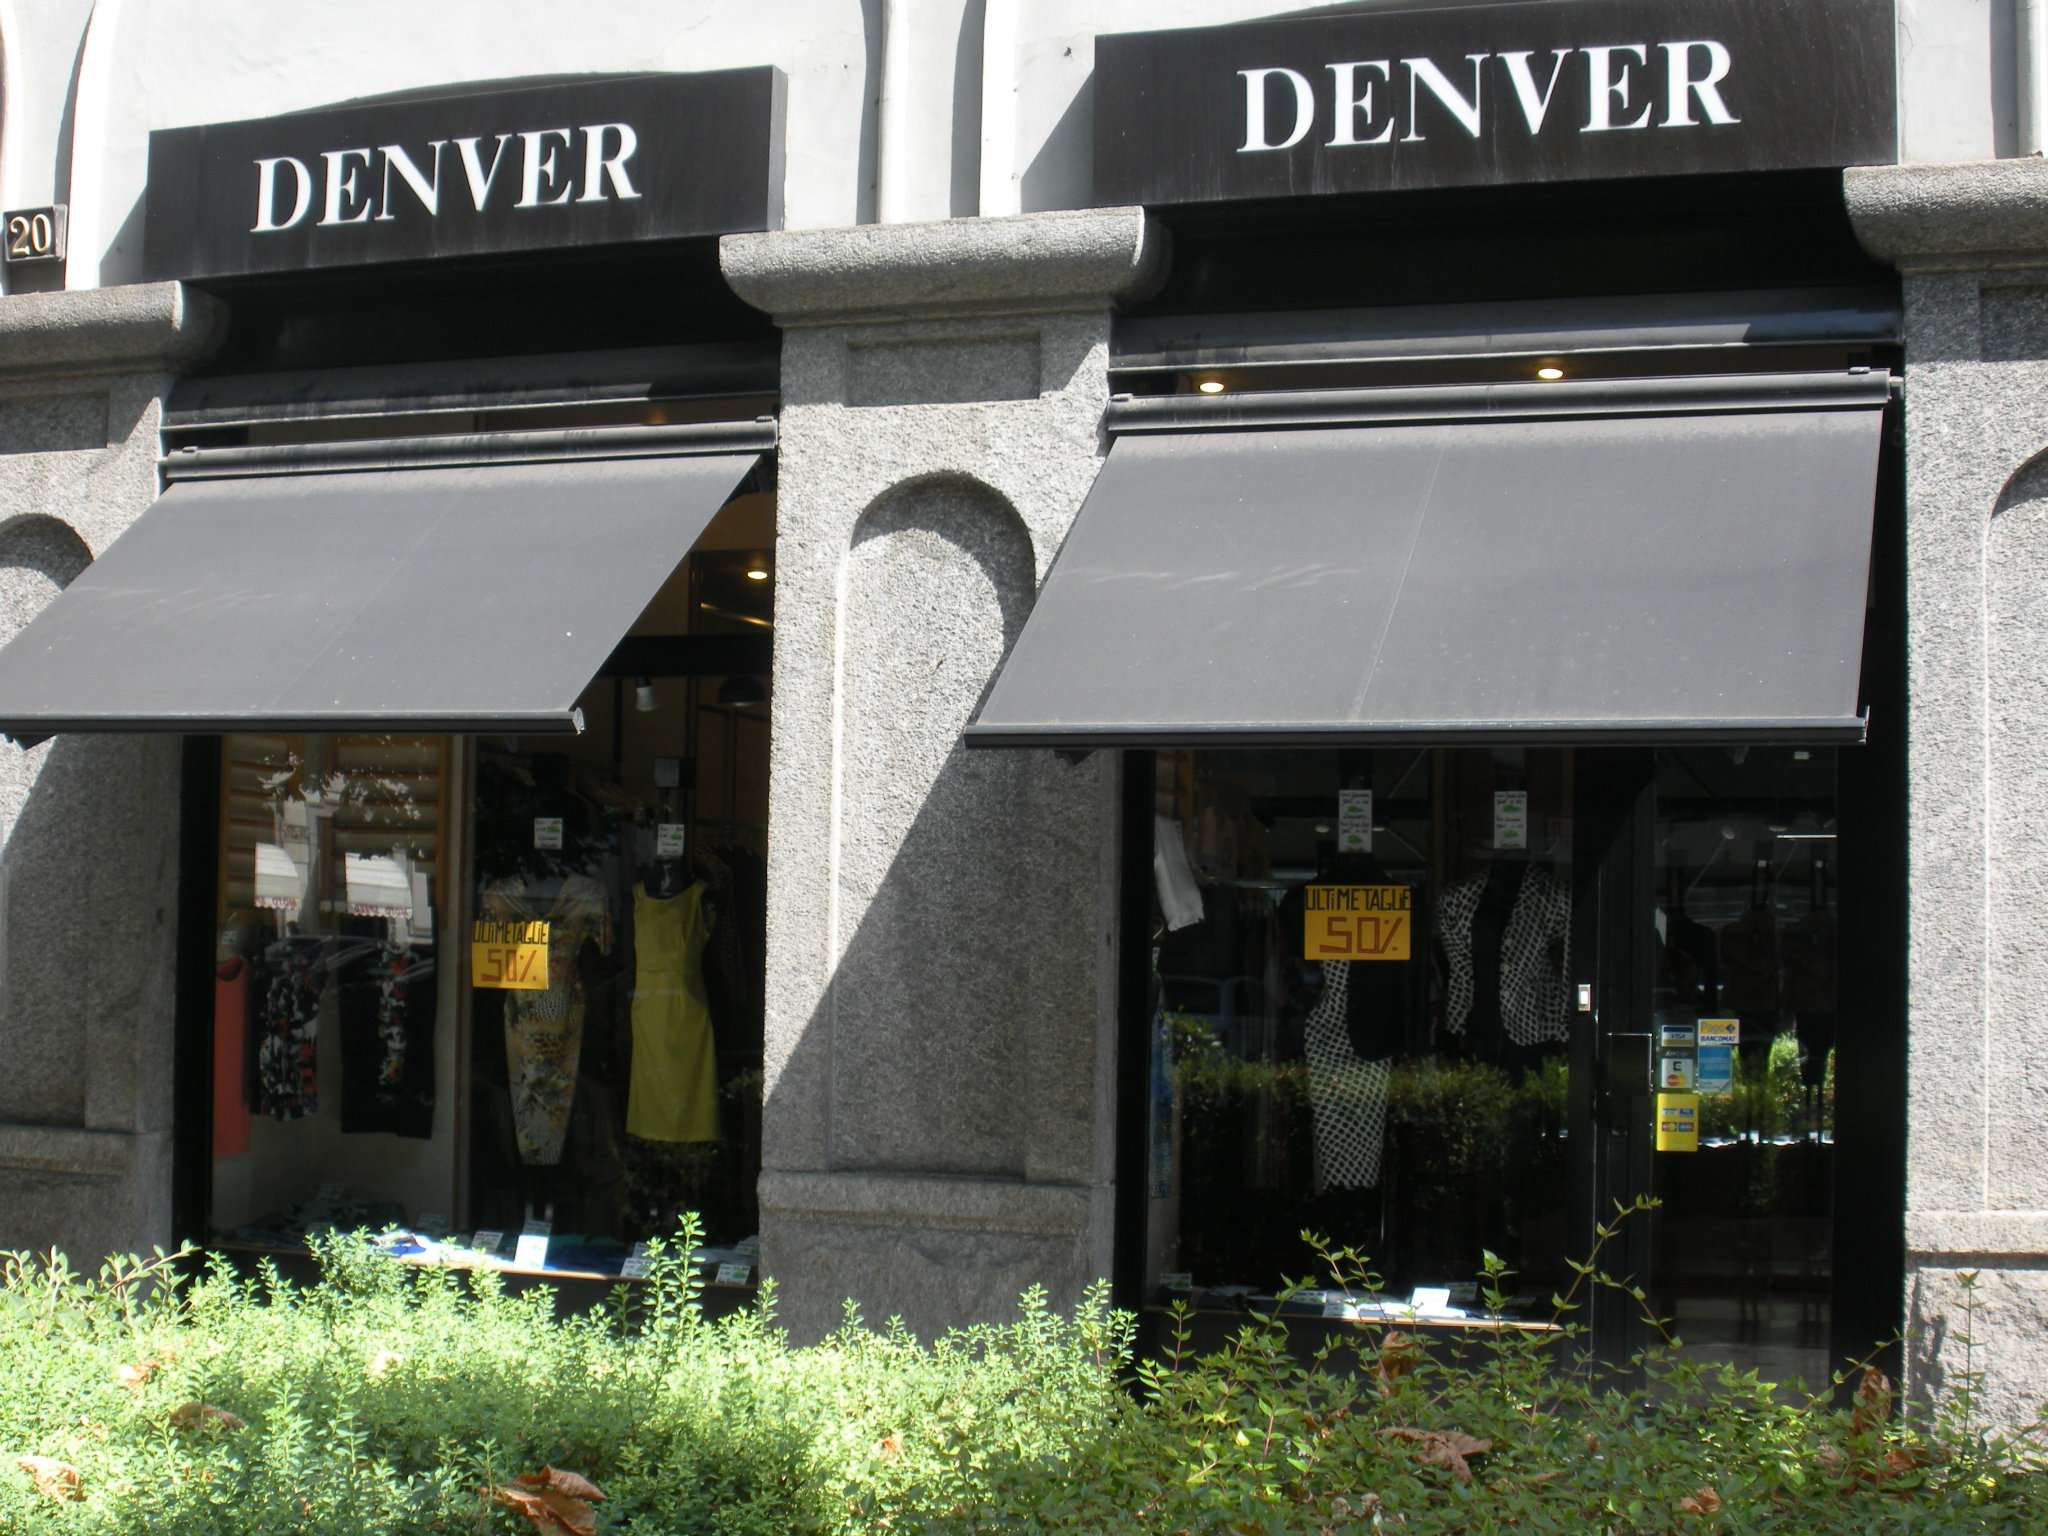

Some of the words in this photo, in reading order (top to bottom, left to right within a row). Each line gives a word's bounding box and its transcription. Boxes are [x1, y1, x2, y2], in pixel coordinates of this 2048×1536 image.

[1236, 39, 1742, 153] DENVER
[250, 122, 642, 233] DENVER
[10, 213, 52, 257] 20
[1319, 916, 1403, 955] 50%
[481, 948, 537, 983] 50%
